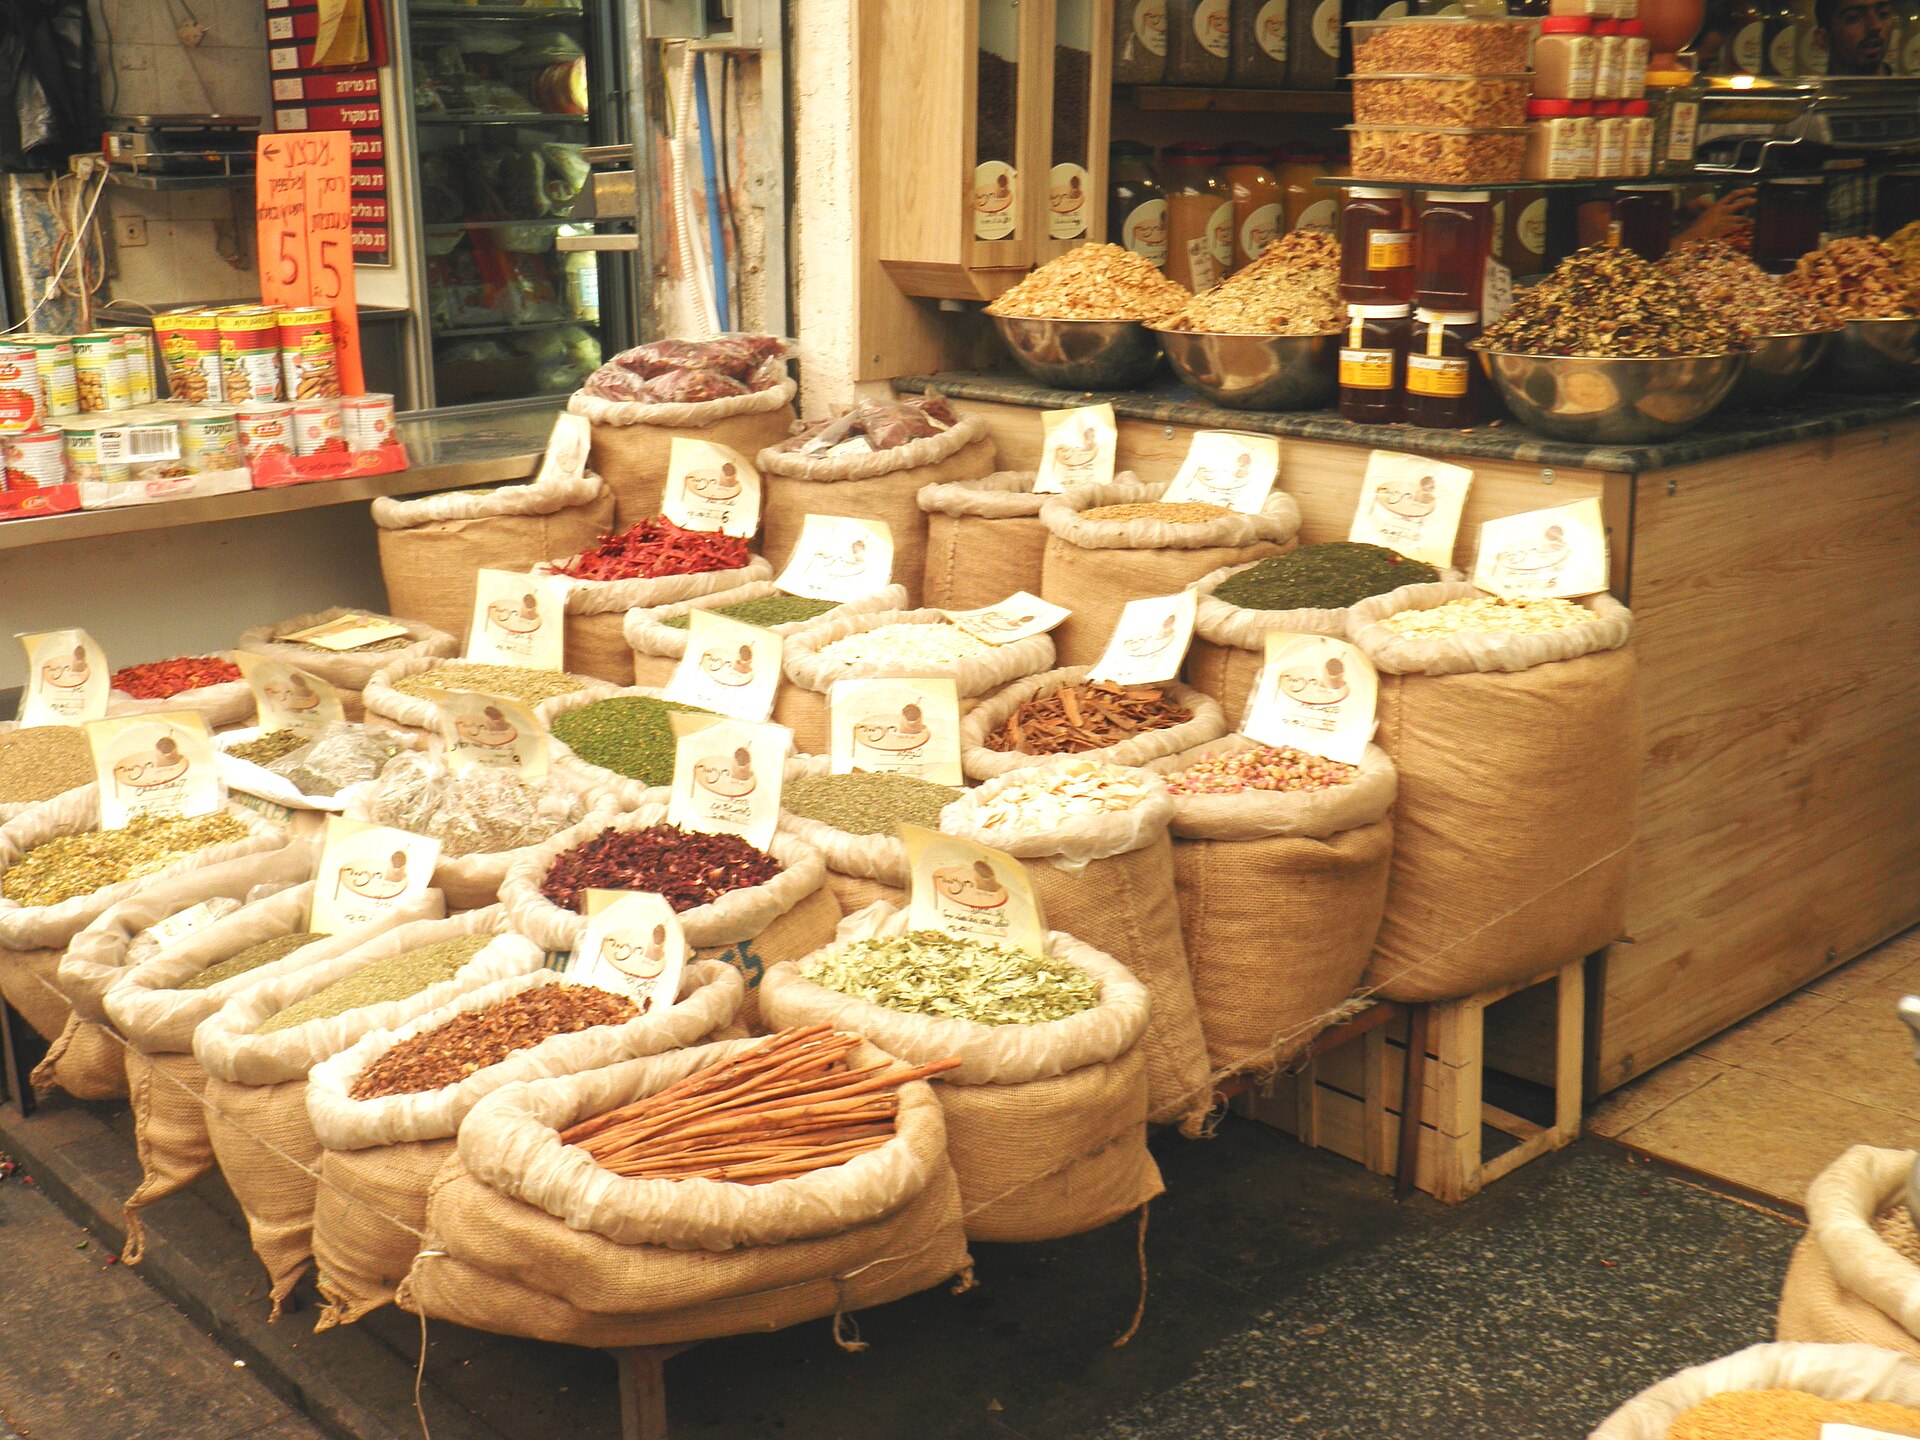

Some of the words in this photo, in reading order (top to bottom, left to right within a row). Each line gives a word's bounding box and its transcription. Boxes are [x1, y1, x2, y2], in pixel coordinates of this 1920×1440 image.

[365, 79, 377, 91] דג
[340, 108, 367, 125] מקרל
[367, 109, 379, 121] דג
[370, 141, 382, 153] דג
[372, 174, 384, 186] דג
[374, 206, 385, 217] דג
[374, 234, 386, 246] דג
[280, 231, 299, 285] 5
[321, 241, 342, 298] 5
